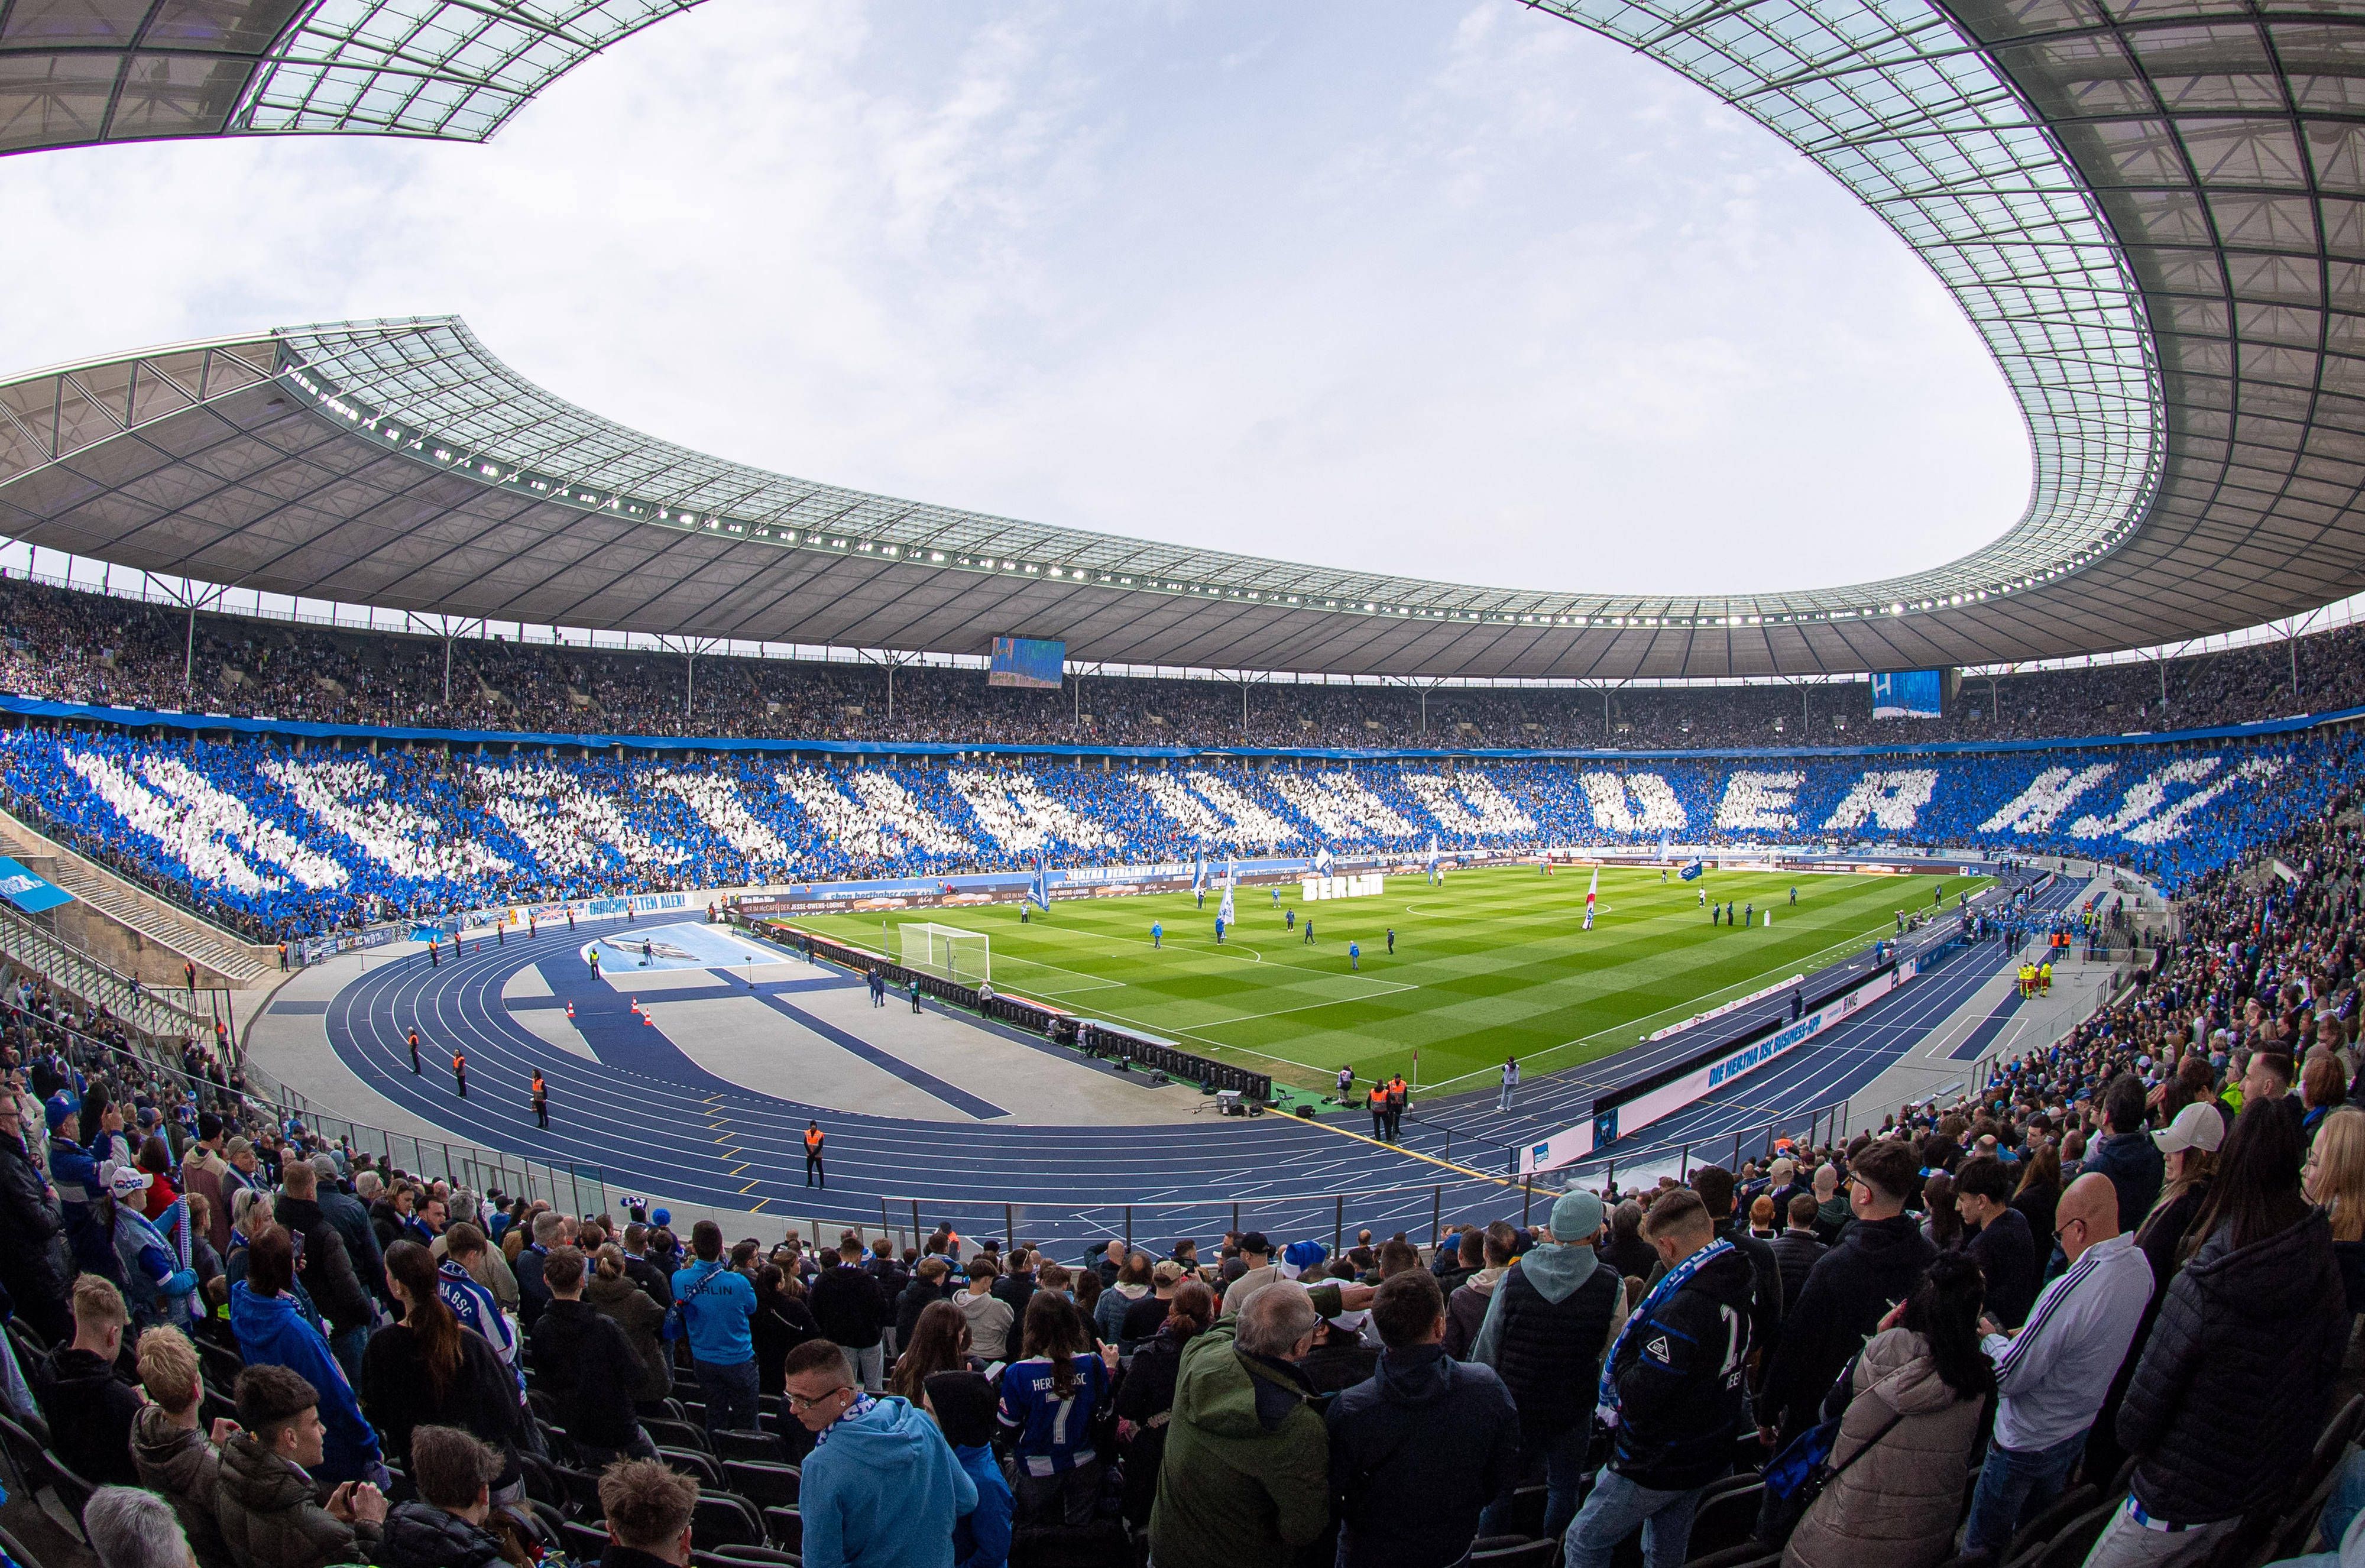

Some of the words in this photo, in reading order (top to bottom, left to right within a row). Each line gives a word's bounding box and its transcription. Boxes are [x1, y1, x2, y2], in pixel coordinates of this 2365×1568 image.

[660, 894, 685, 908] ALEX!
[1708, 1062, 1725, 1088] DIE
[1725, 1047, 1758, 1079] HERTHA
[1758, 1038, 1774, 1062] BSC
[1773, 1014, 1822, 1054] BUSINESS-APP
[683, 1284, 733, 1296] BRLIN
[451, 1291, 472, 1317] BSC
[1045, 1392, 1075, 1444] 7
